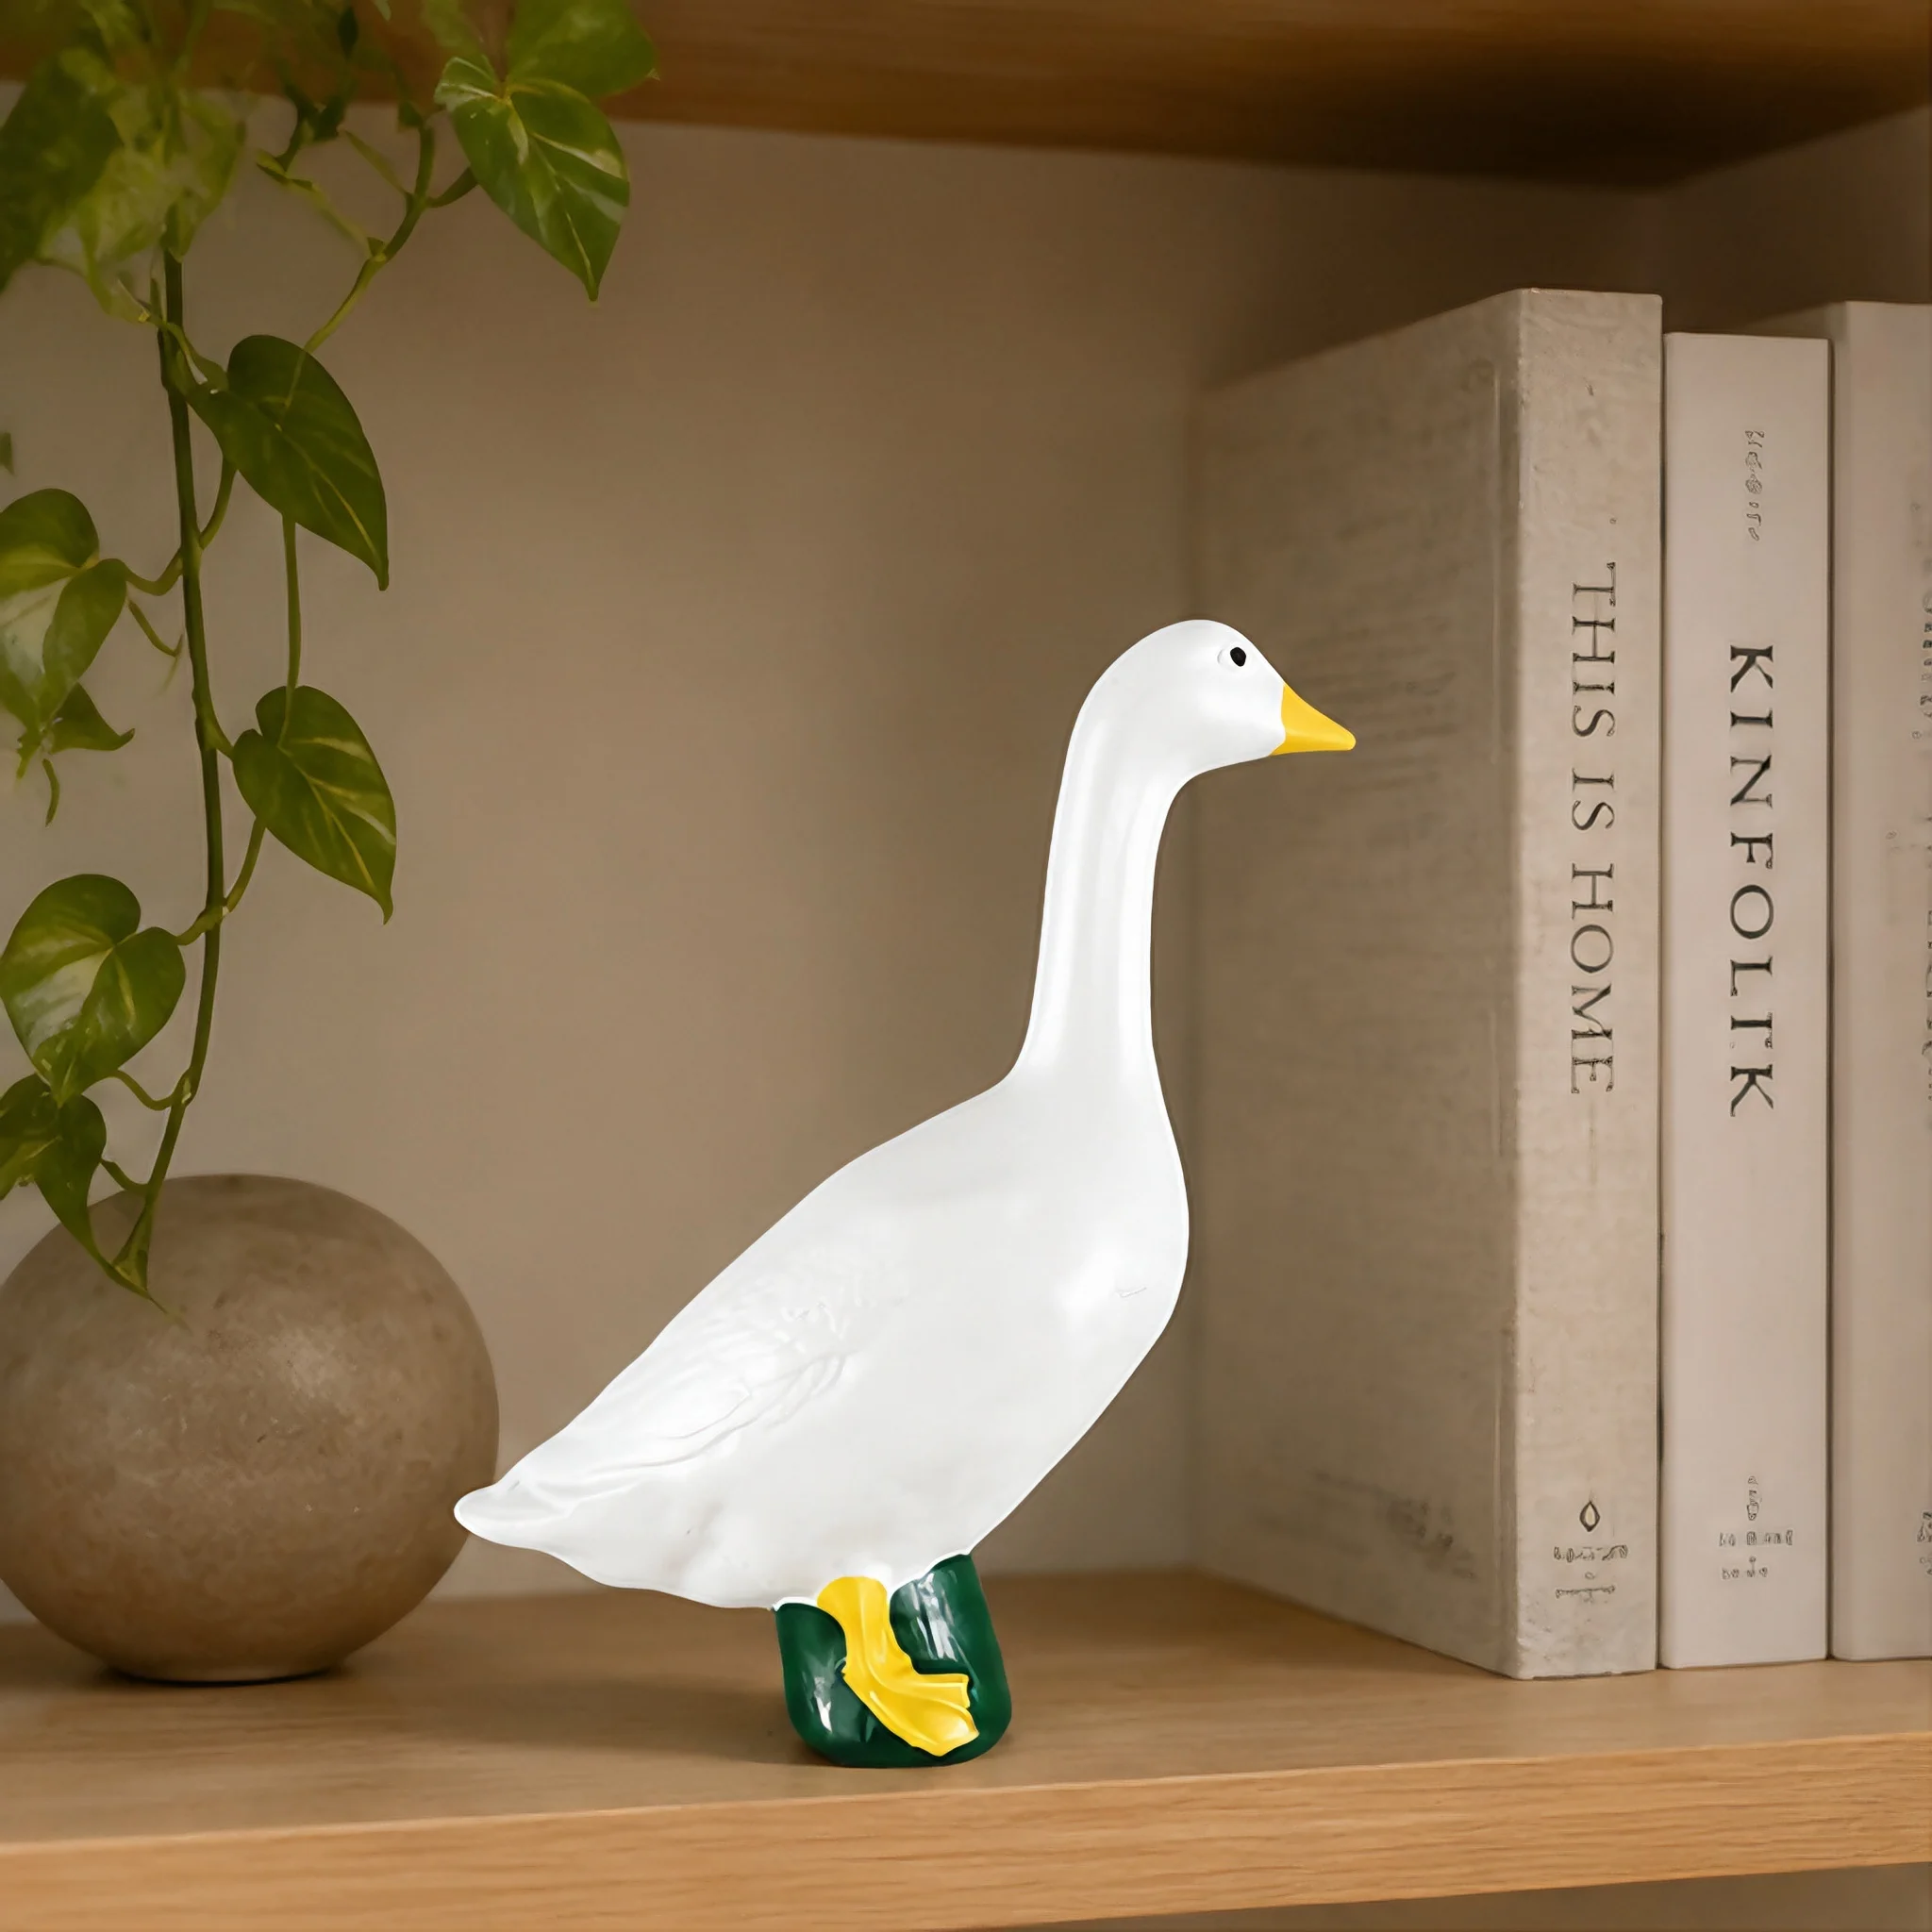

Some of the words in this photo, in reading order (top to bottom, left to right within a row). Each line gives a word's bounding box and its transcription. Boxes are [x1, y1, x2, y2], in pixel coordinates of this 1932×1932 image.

[1572, 562, 1616, 738] THIS
[1571, 768, 1615, 831] IS
[1571, 862, 1615, 1094] HOME
